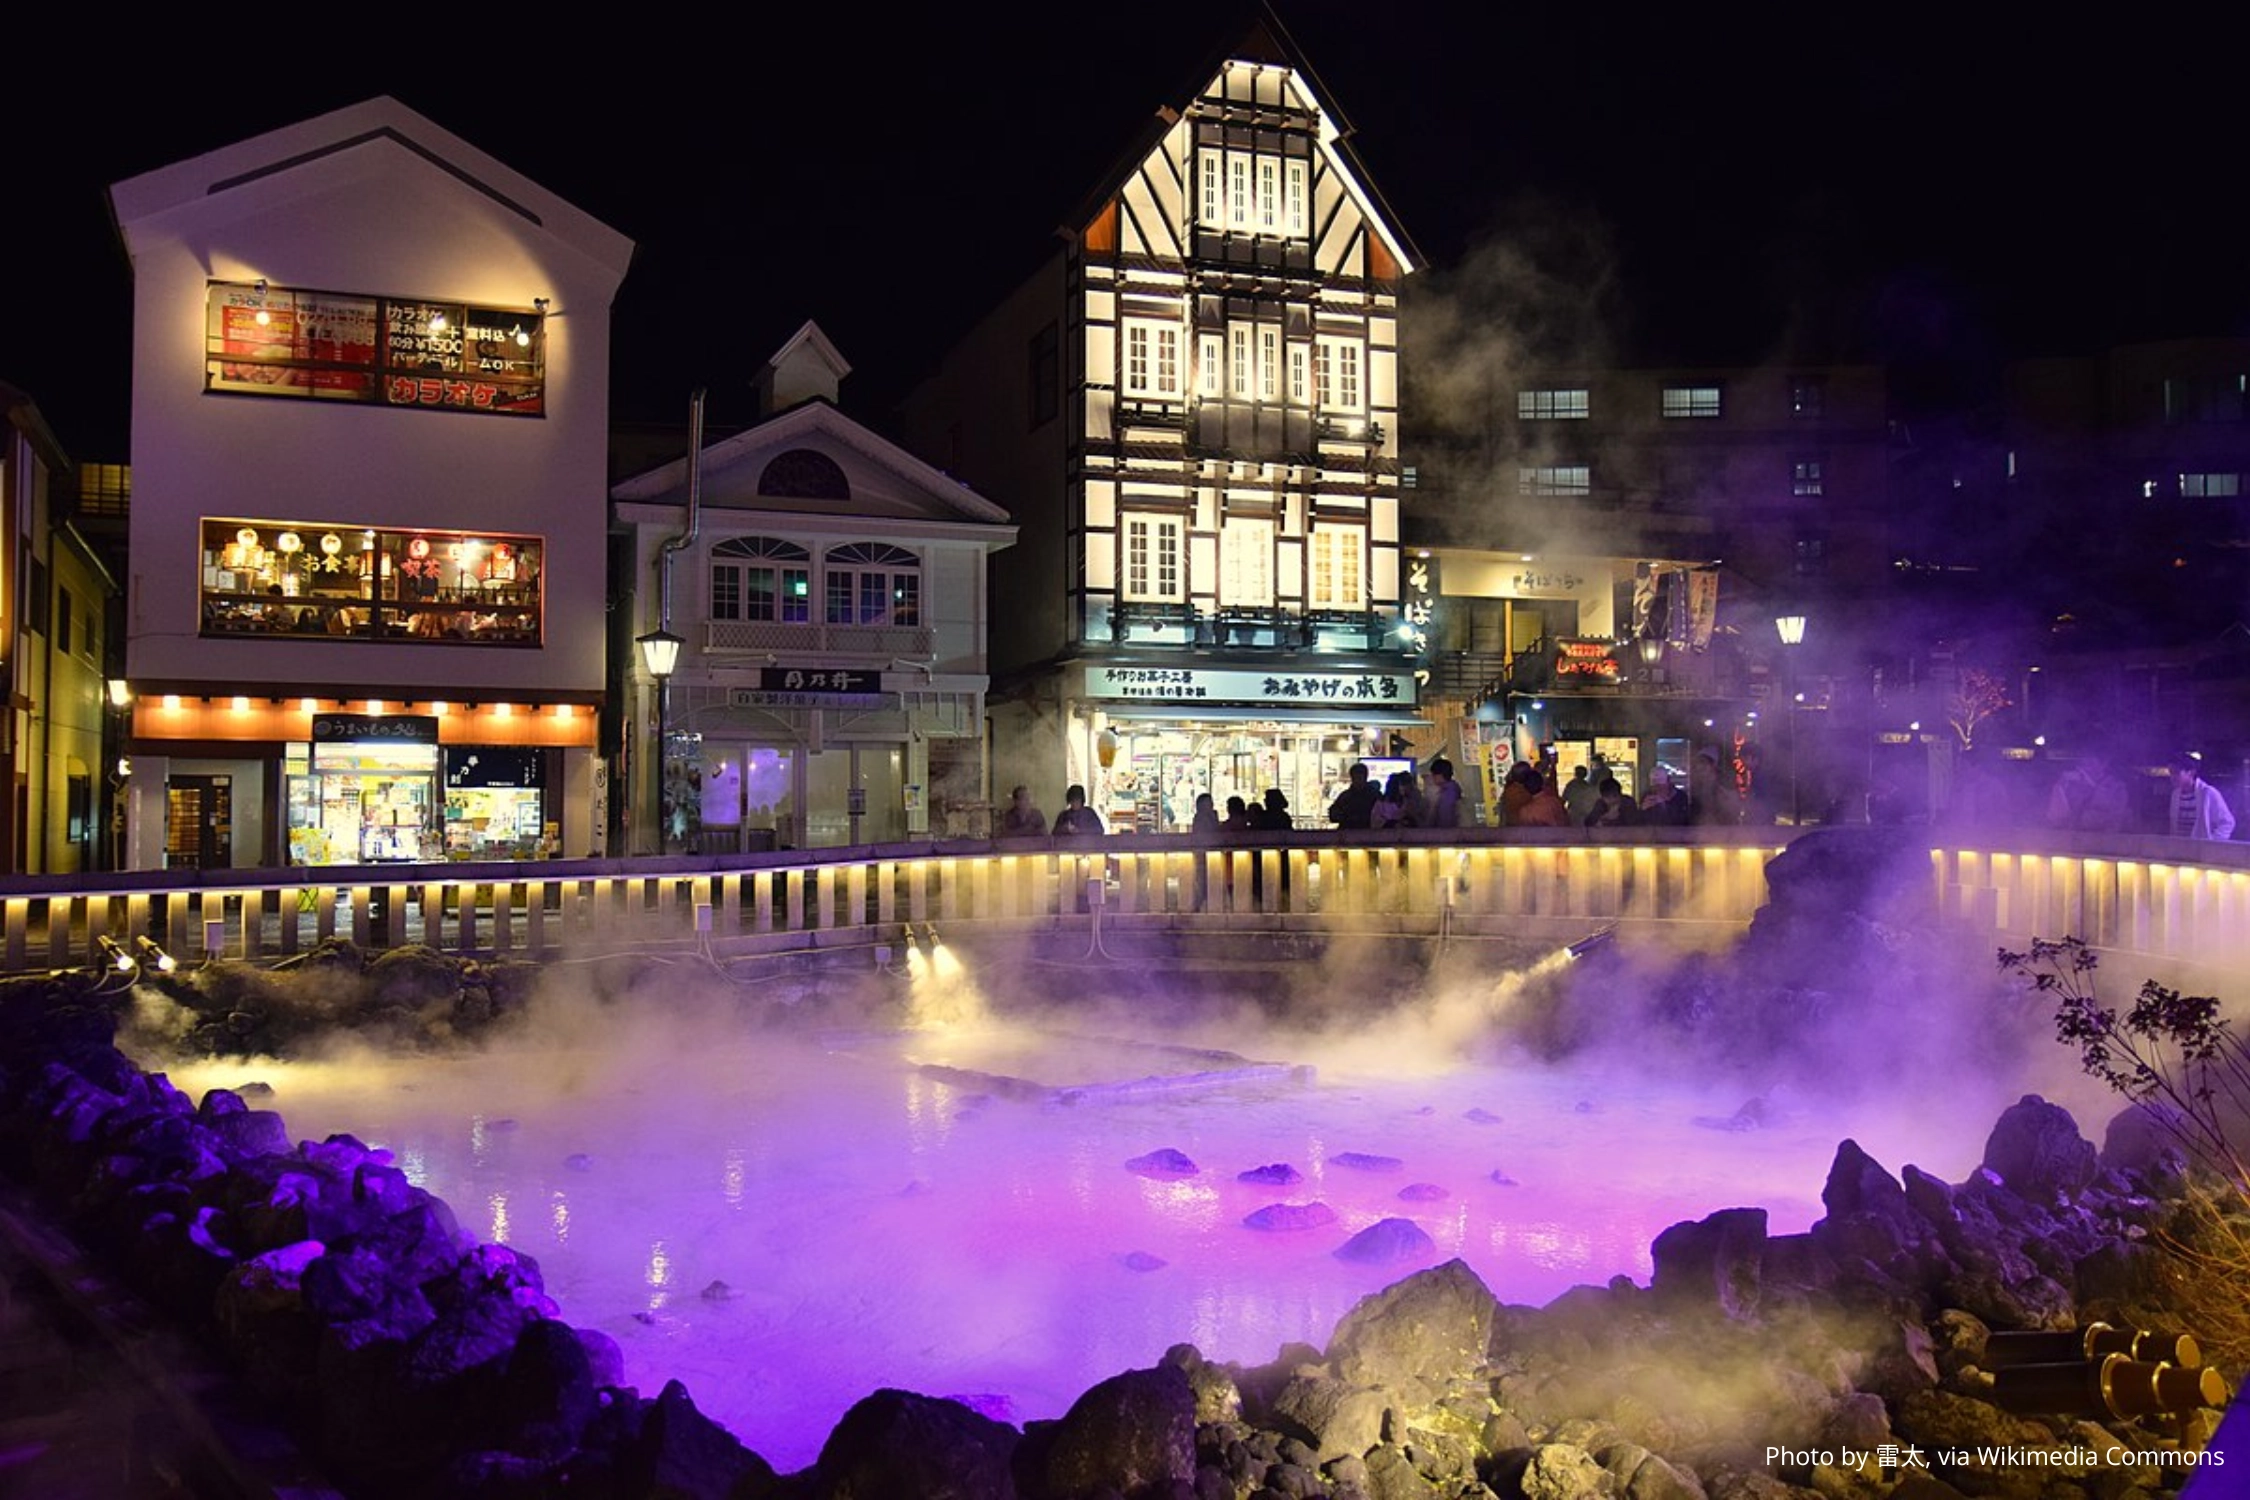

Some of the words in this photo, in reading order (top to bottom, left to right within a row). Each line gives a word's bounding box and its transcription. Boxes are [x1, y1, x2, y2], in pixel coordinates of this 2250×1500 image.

[390, 306, 443, 322] カラオケ
[393, 376, 498, 408] カラオケ
[1260, 675, 1399, 698] おみやげの本多
